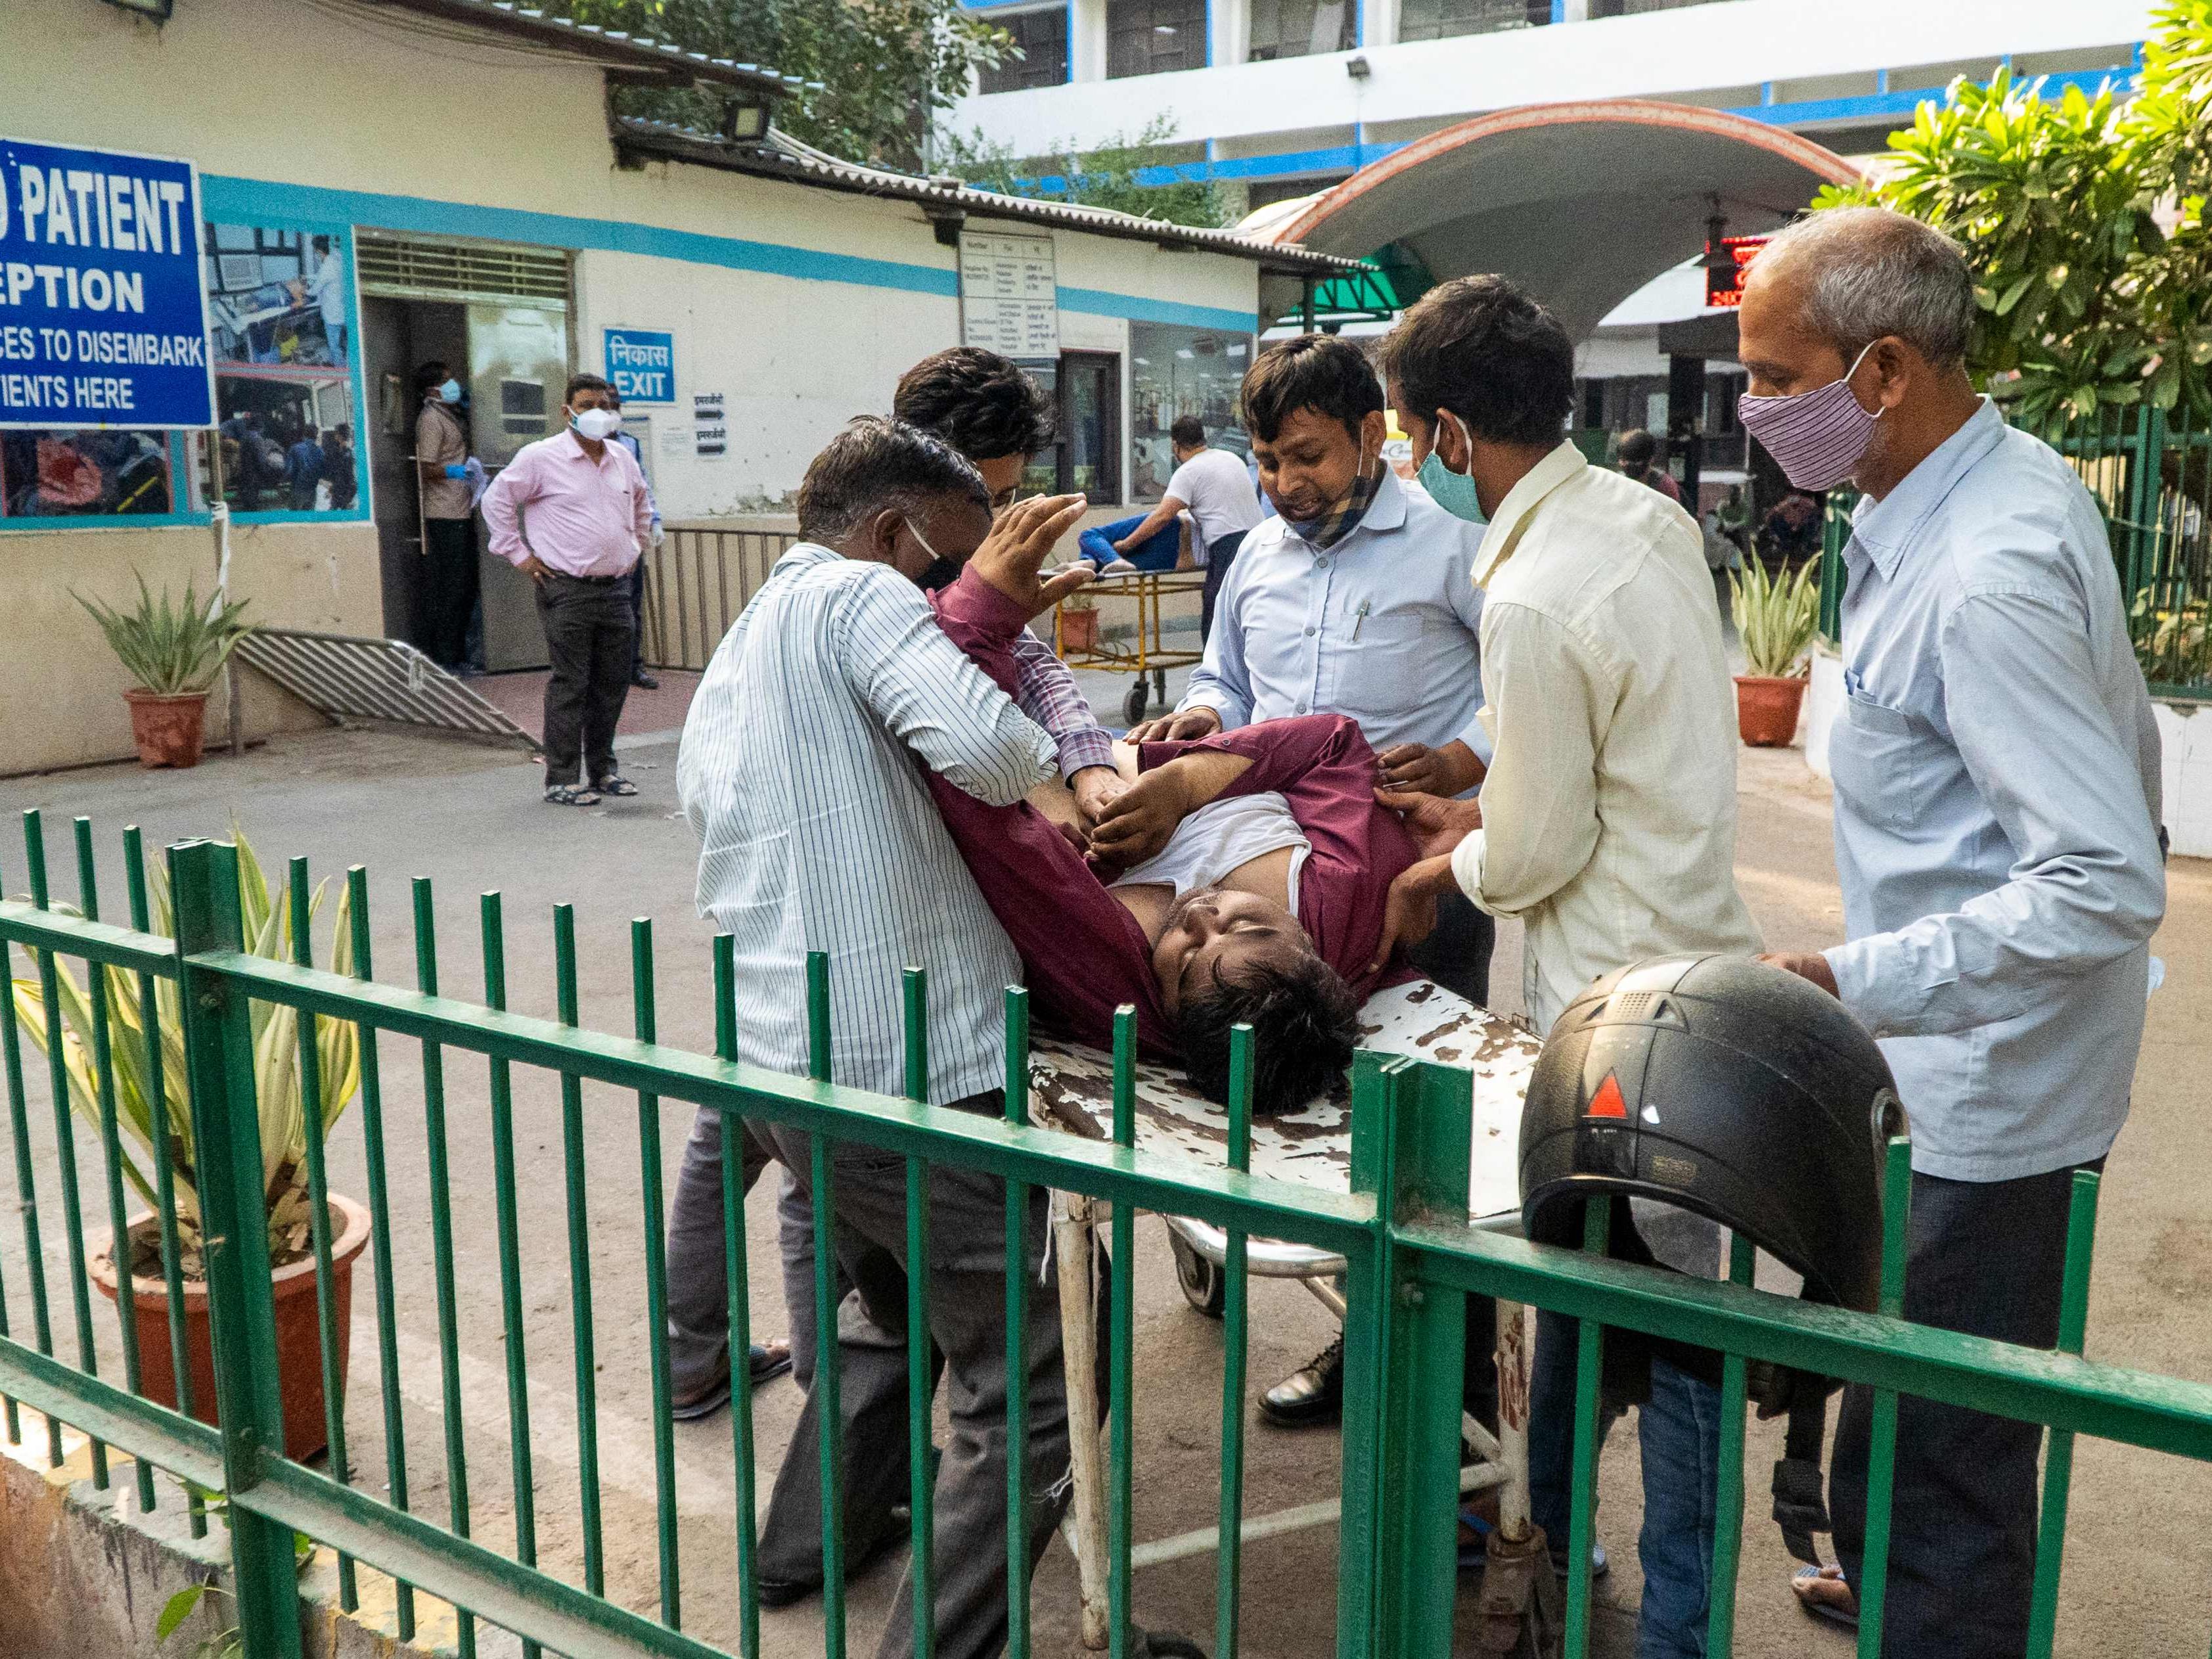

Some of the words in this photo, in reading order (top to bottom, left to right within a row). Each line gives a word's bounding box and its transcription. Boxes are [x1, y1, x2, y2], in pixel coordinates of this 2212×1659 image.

[19, 164, 184, 255] PATIENT
[0, 262, 145, 313] PTION
[0, 326, 35, 361] ES
[39, 329, 71, 362] TO
[77, 330, 204, 367] DISEMBARK
[608, 335, 669, 369] निकास
[0, 374, 70, 408] IENTS
[74, 376, 135, 409] HERE
[614, 371, 666, 397] EXIT
